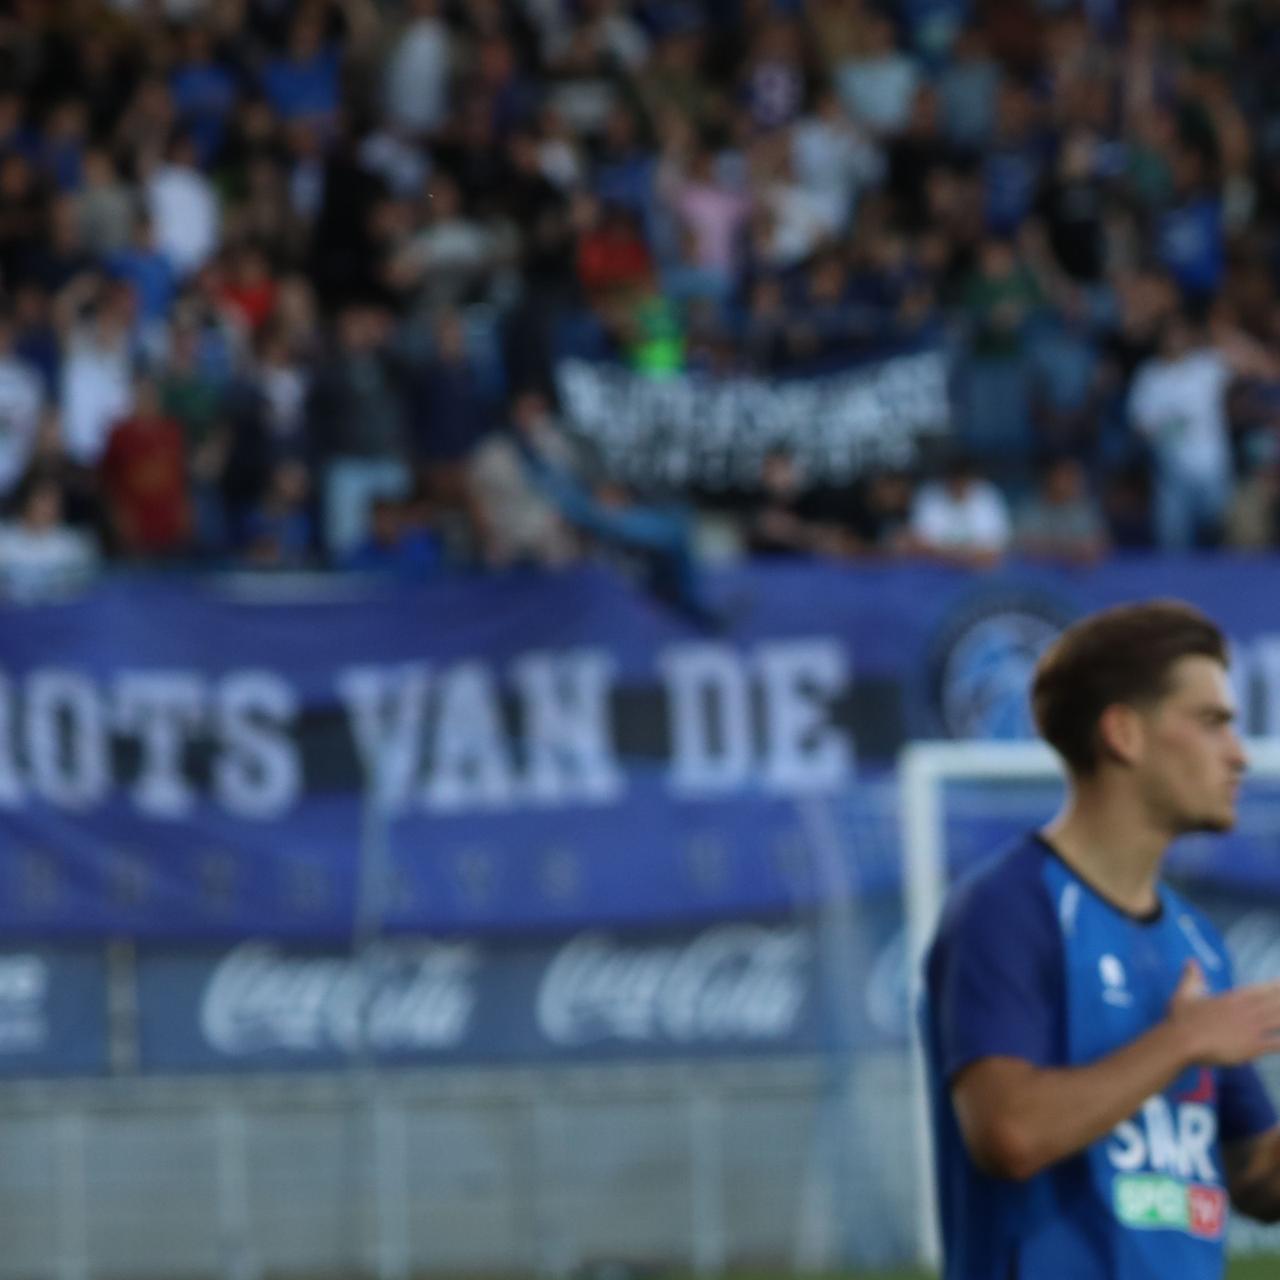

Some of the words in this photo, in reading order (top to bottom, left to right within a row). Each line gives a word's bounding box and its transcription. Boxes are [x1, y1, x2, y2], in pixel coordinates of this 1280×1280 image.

[0, 664, 300, 822] OTS
[338, 650, 622, 812] VAN
[656, 636, 856, 794] DE
